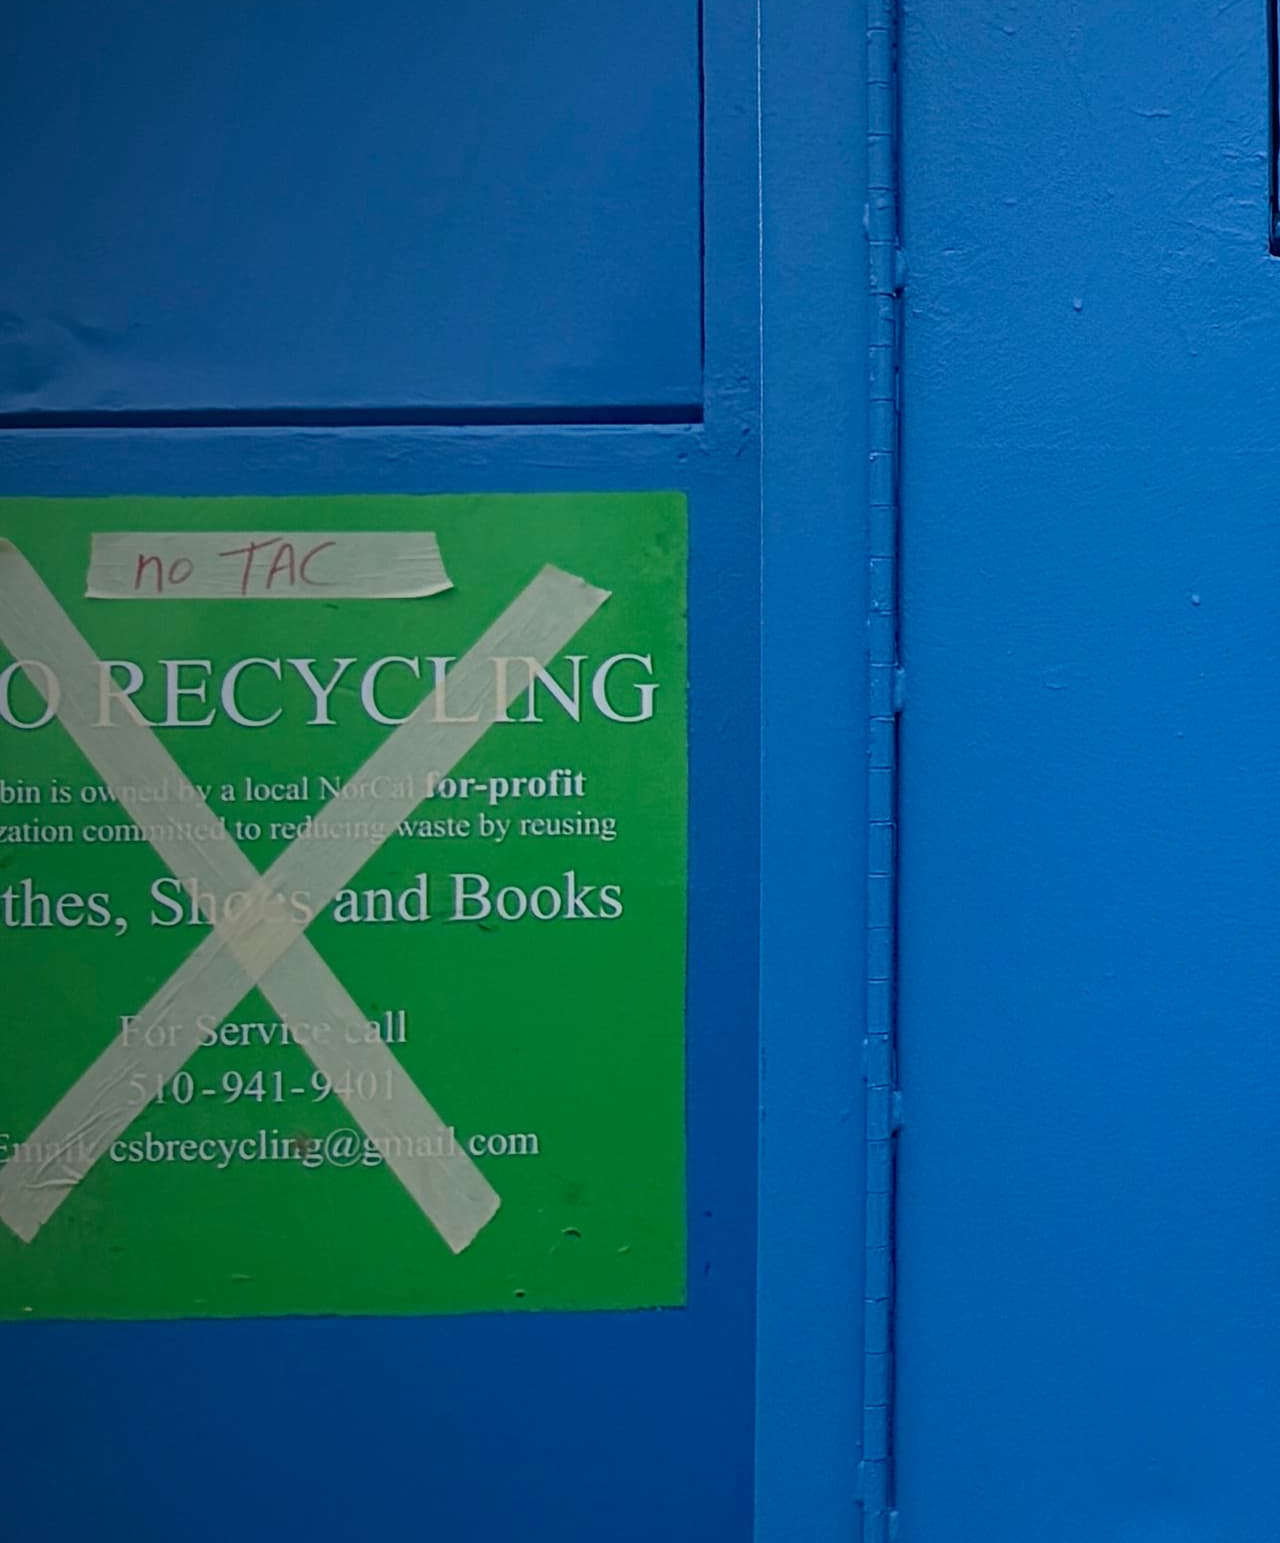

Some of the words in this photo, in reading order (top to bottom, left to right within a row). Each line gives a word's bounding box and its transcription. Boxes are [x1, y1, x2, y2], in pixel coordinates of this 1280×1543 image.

[134, 553, 195, 593] no
[0, 659, 60, 730] O
[93, 653, 661, 729] RECYCLING
[0, 778, 42, 805] bin
[51, 779, 73, 804] is
[80, 775, 169, 803] owned
[178, 775, 216, 812] by
[220, 782, 237, 803] a
[244, 775, 310, 803] local
[318, 770, 415, 802] NorCal
[424, 768, 588, 806] for-profit
[0, 817, 74, 844] zation
[82, 812, 228, 843] committed
[235, 820, 263, 840] to
[269, 814, 385, 845] reducing
[396, 815, 470, 839] waste
[479, 812, 512, 842] by
[519, 810, 618, 841] reusing
[0, 877, 129, 938] thes,
[332, 871, 432, 924] and
[445, 868, 625, 922] Books
[119, 1013, 183, 1048] For
[195, 1012, 332, 1048] Service
[343, 1008, 408, 1045] call
[126, 1067, 396, 1107] 510-941-9401
